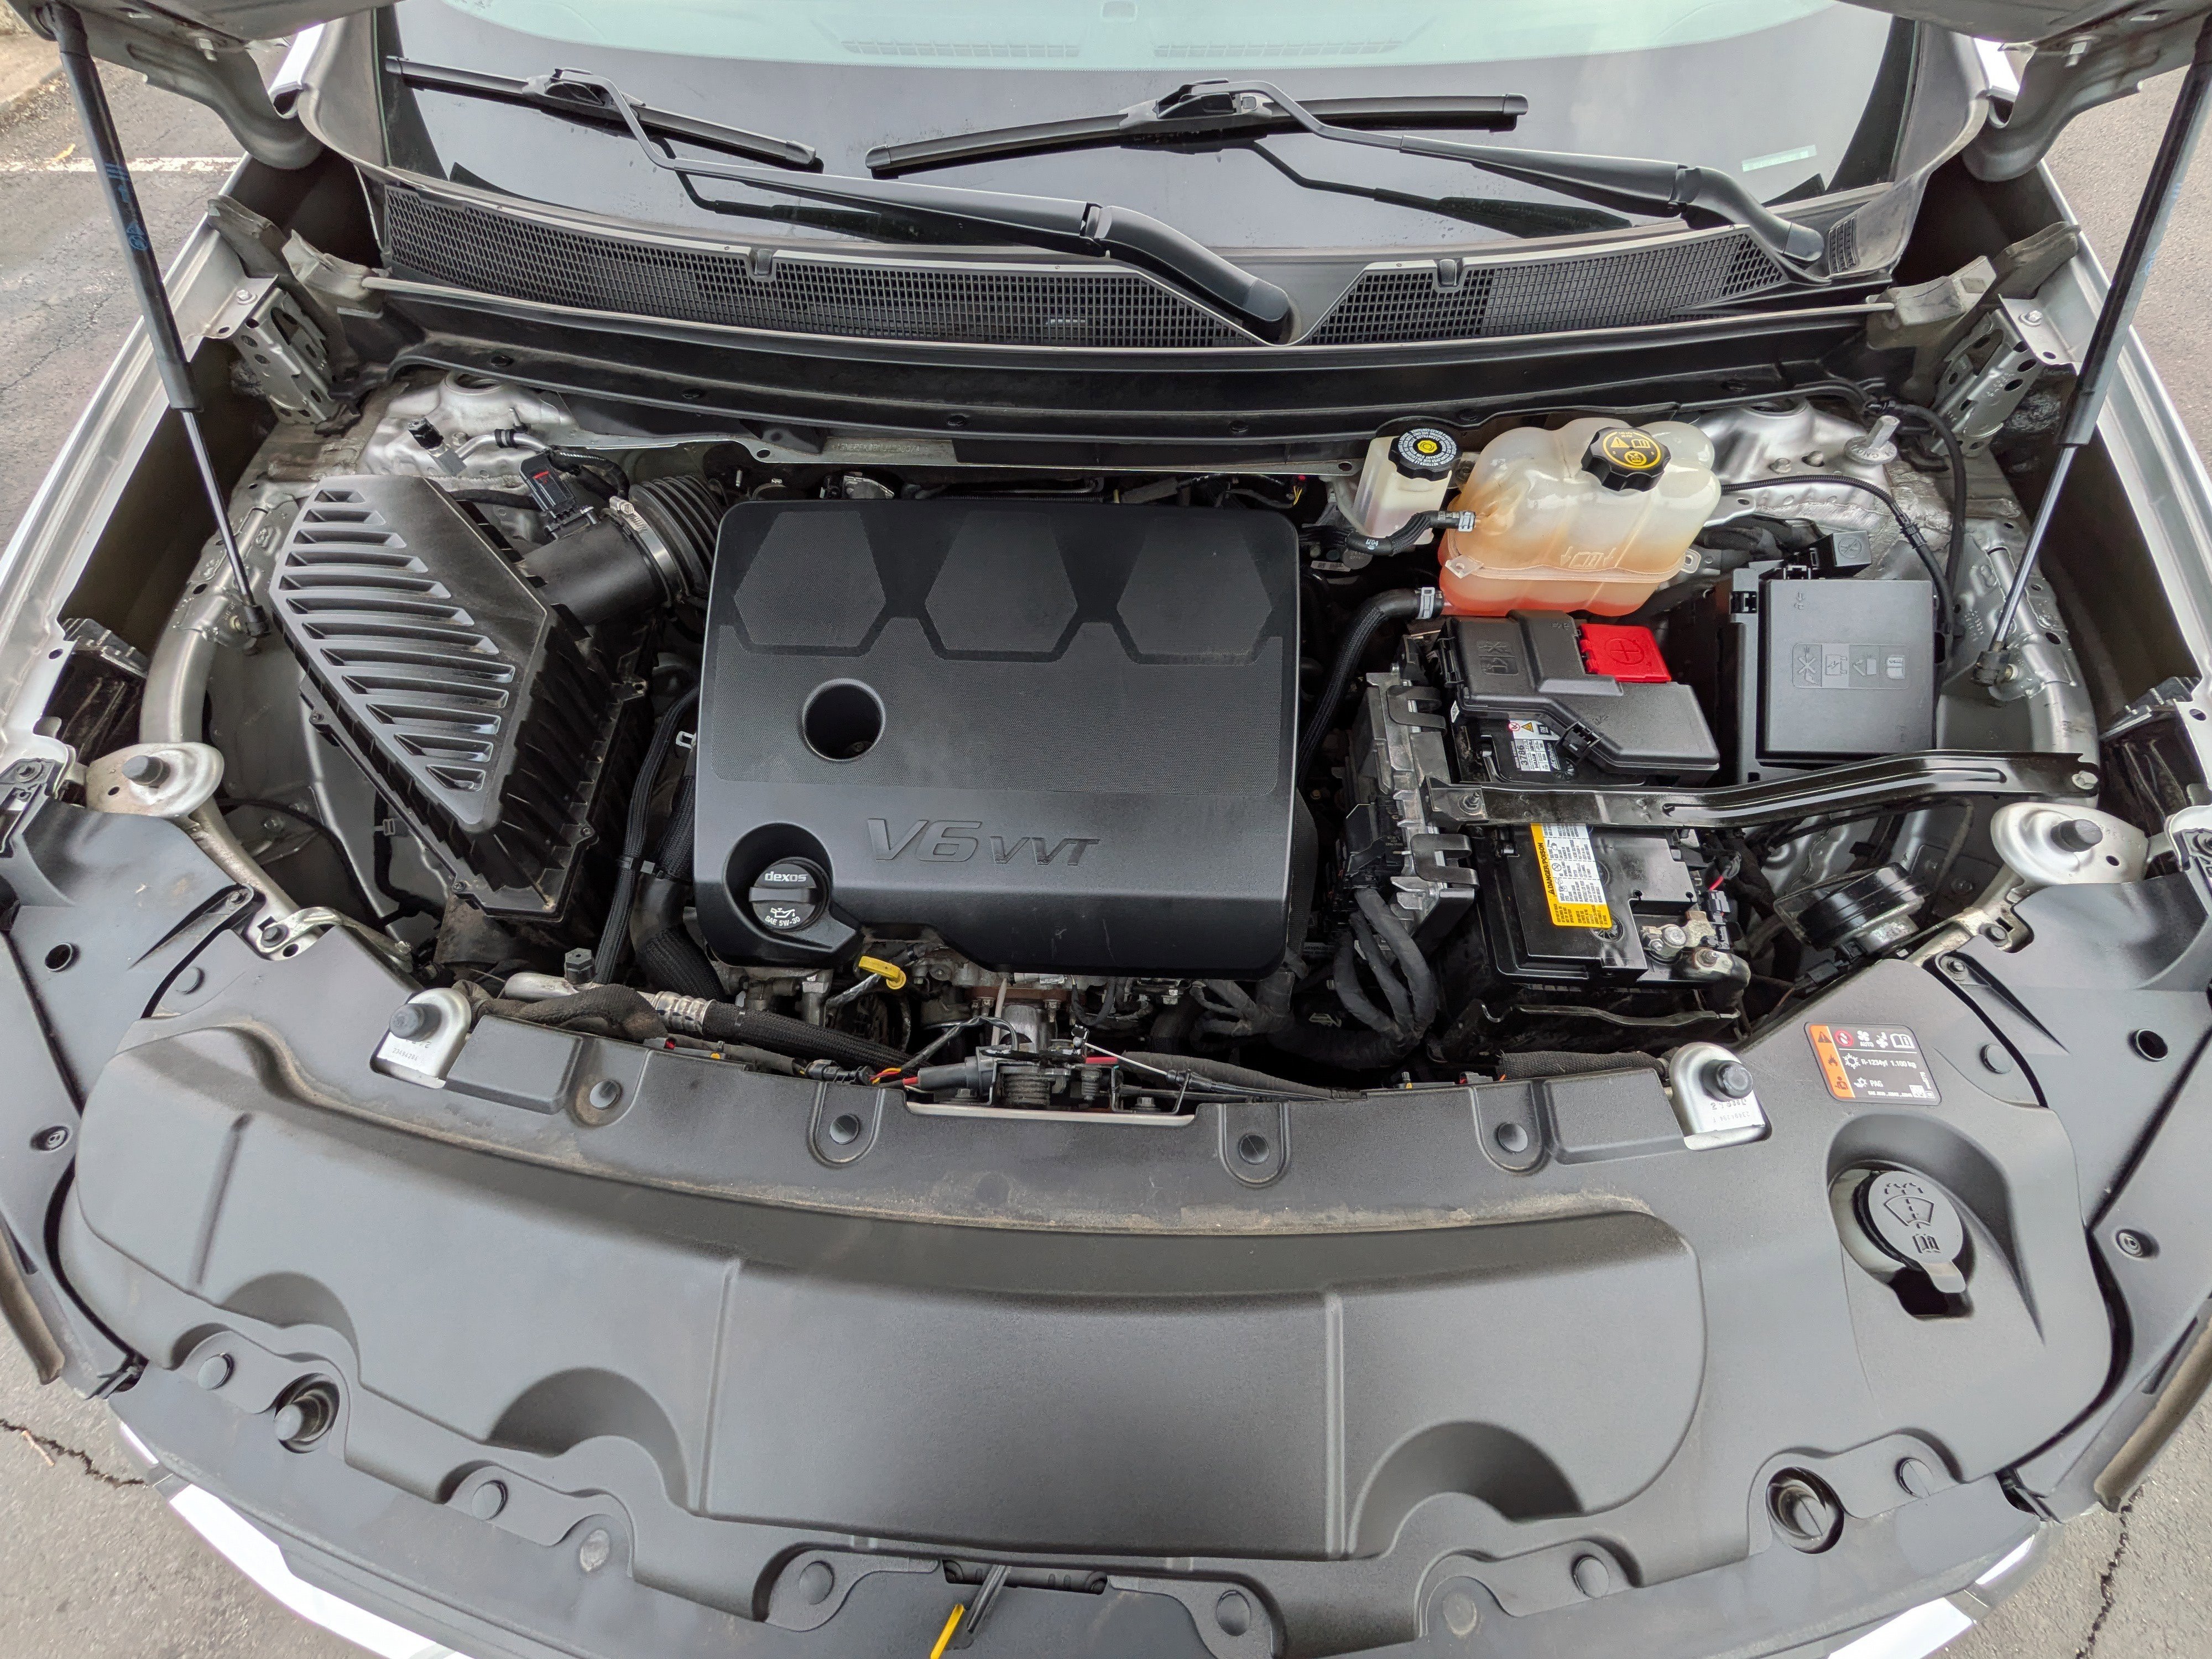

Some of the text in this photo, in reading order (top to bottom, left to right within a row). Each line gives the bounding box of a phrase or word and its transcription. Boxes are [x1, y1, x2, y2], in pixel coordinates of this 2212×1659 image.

[1517, 745, 1528, 766] 3786
[867, 818, 1100, 866] V6 VVT
[1537, 842, 1553, 889] DANGER/POISON
[764, 871, 807, 882] dexos
[765, 915, 801, 926] SAE 5W-30
[1907, 1061, 1917, 1069] kg
